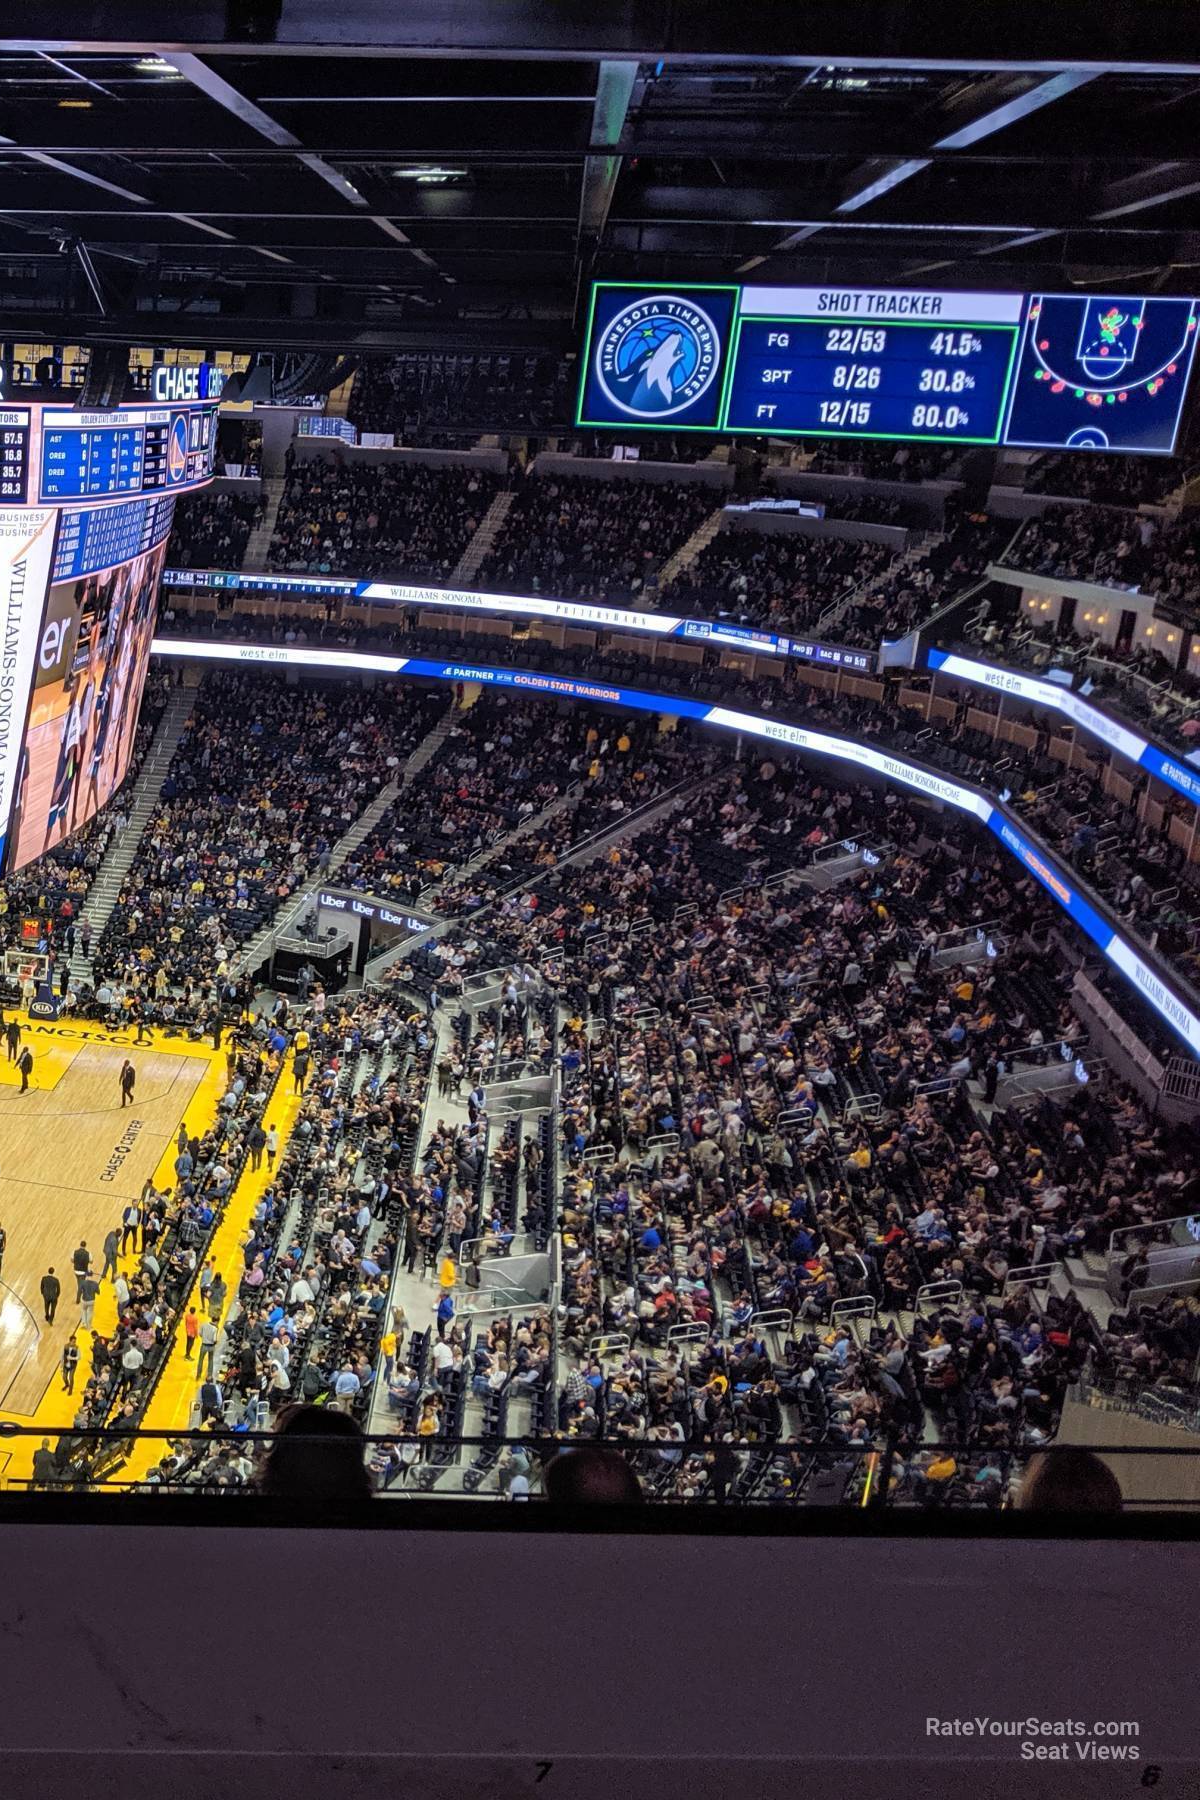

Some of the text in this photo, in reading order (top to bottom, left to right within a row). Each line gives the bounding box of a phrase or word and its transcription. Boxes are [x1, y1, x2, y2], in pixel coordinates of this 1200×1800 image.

[817, 293, 942, 315] SHOT TRACKER
[604, 303, 714, 398] MINNESOTA TIMBERWOLVES
[767, 330, 982, 355] FG 22/53 41.5%
[156, 367, 199, 400] CHASE
[761, 368, 976, 392] 3PT 8/26 30.8%
[756, 402, 969, 428] FT 12/15 80.0%
[4, 433, 23, 445] 57.5
[5, 450, 22, 461] 16.8
[3, 466, 21, 478] 35.7
[2, 483, 21, 494] 28.3
[0, 513, 45, 523] BUSINESS
[19, 522, 27, 530] TO
[390, 588, 483, 605] WILLIAMS SONOMA
[240, 647, 288, 660] west elm
[453, 668, 494, 681] PARTNER
[514, 676, 549, 688] GOLDEN
[550, 681, 574, 692] STATE
[576, 685, 620, 700] WARRIORS
[985, 672, 1022, 691] west elm
[765, 725, 960, 800] west elm WILLIAMS SONOMA HOME
[321, 895, 346, 908] Uber
[352, 901, 375, 916] Uber
[380, 909, 403, 925] Uber
[100, 1120, 144, 1181] CHASE CENTER
[535, 1761, 553, 1783] 7
[1141, 1764, 1162, 1787] 6
